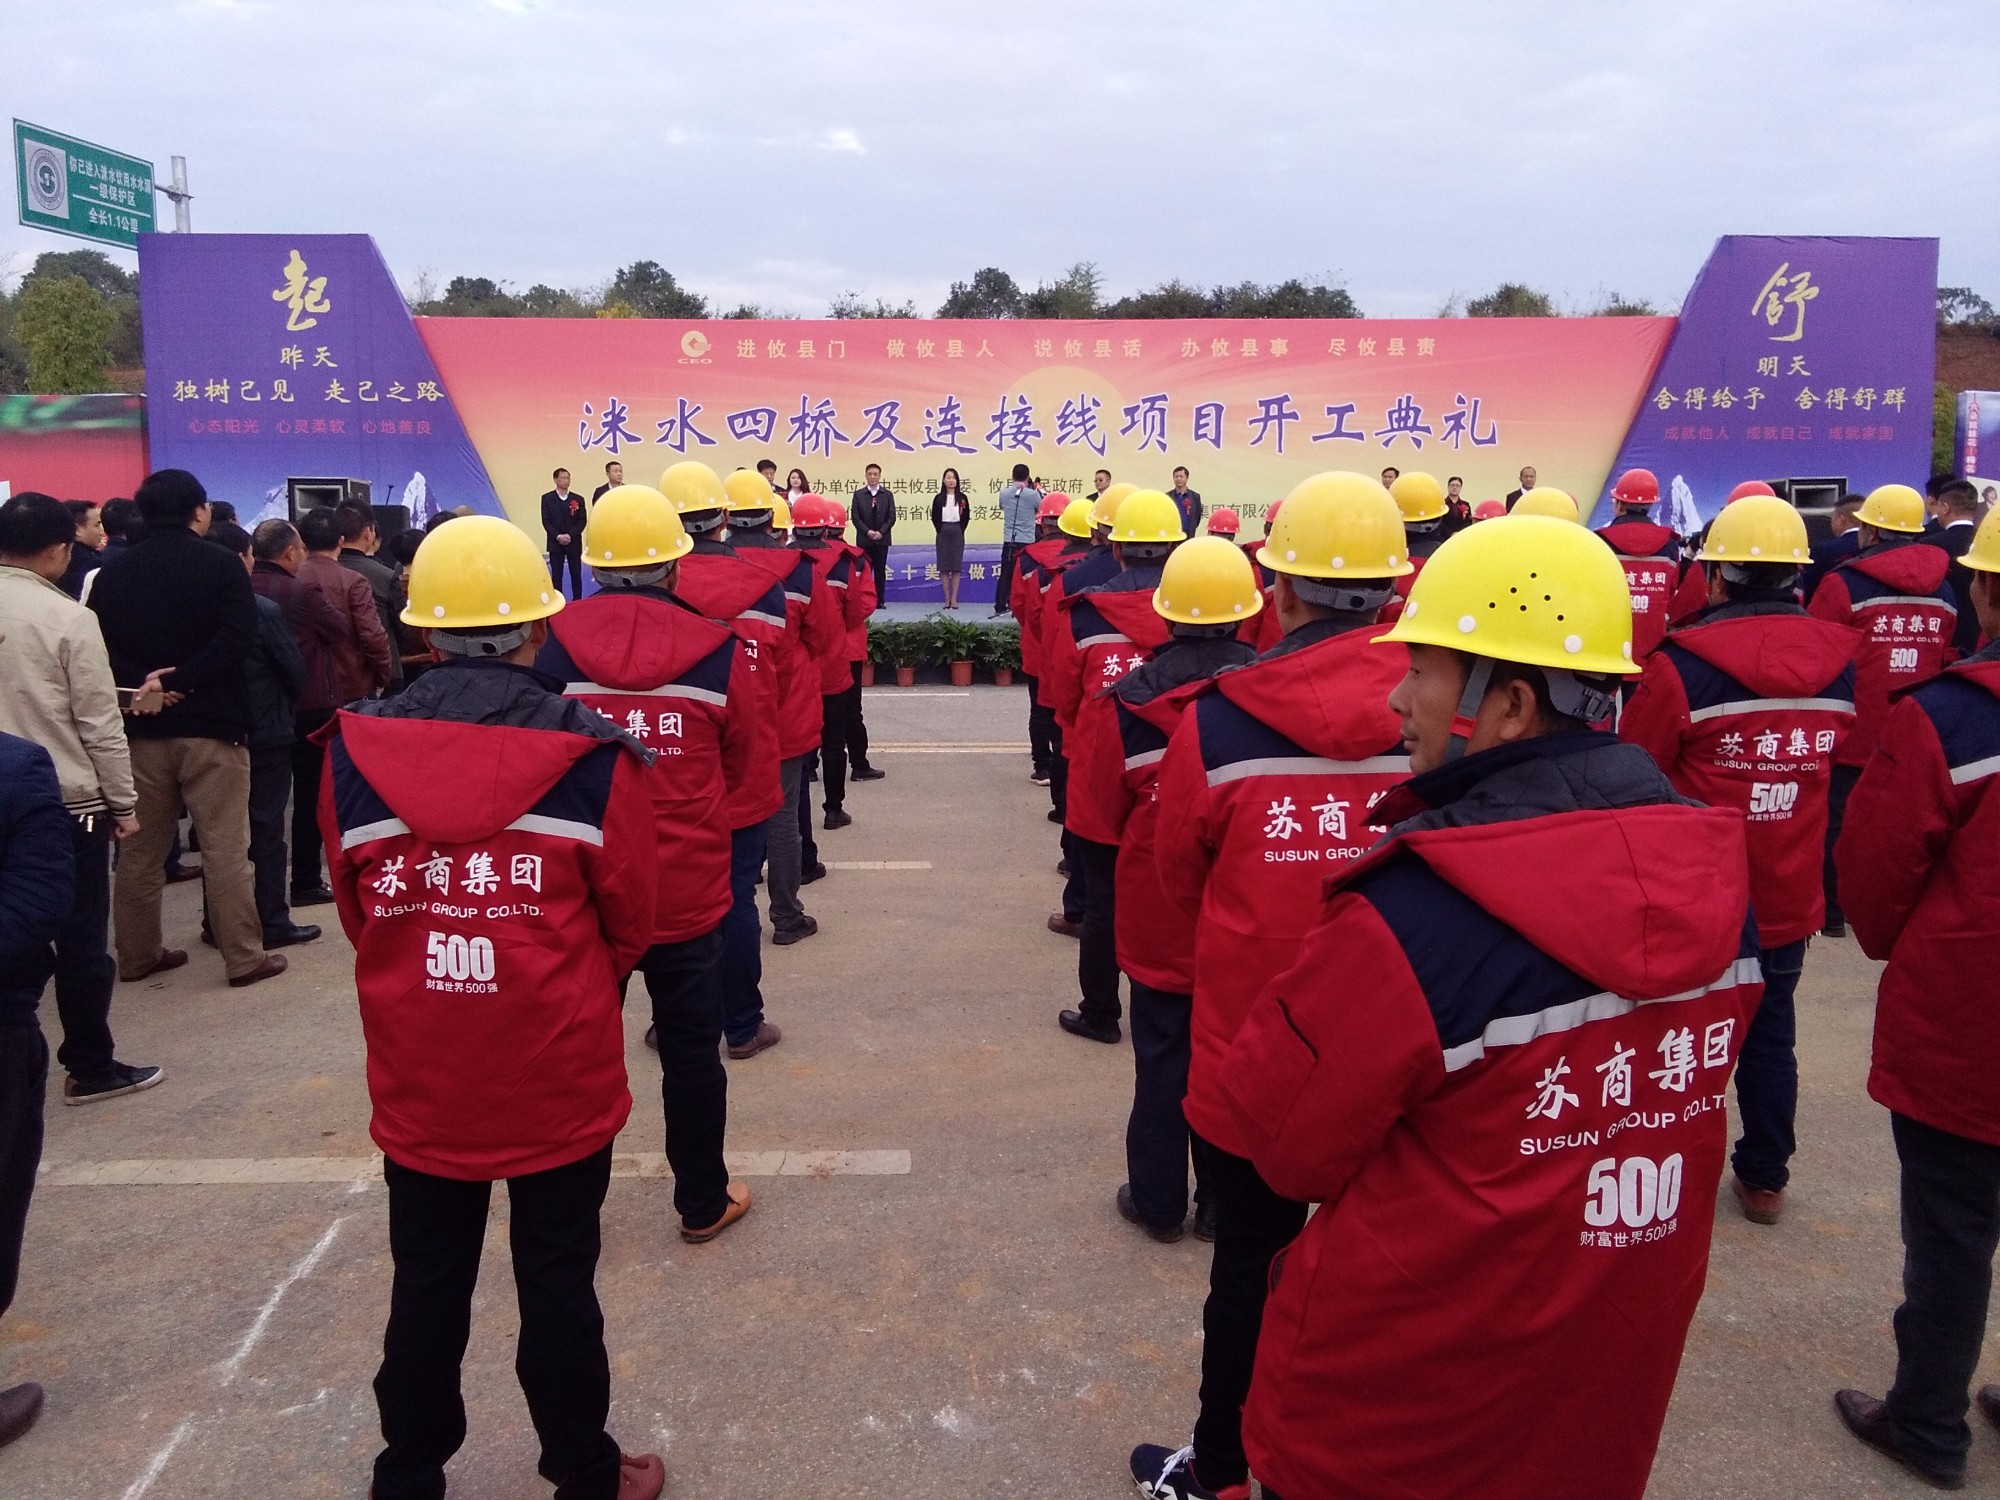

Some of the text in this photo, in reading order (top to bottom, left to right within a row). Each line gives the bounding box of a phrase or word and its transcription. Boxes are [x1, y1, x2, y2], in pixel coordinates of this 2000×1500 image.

[89, 183, 136, 207] 一级保护区
[89, 207, 139, 233] 全长1.1公里
[1752, 262, 1820, 342] 舒
[280, 344, 338, 370] 昨天
[737, 337, 1436, 358] 进攸县门 做攸县人 说攸县话 办攸县事 尽攸县责
[1757, 355, 1812, 378] 明天
[1653, 386, 1906, 412] 舍得给予 舍得舒群
[189, 419, 432, 435] 心态阳光 心灵柔软 心地善良
[1663, 426, 1730, 440] 成就他人
[1746, 426, 1813, 440] 成就自己
[1873, 615, 1941, 634] 苏商集团
[1889, 648, 1918, 668] 500
[1716, 728, 1835, 760] 苏商集团
[1757, 762, 1797, 772] GROUP
[1750, 781, 1799, 814] 500
[1264, 850, 1319, 863] SUSUN
[372, 850, 543, 898] 苏商集团
[374, 901, 427, 918] SUSUN
[431, 902, 478, 919] GROUP
[426, 930, 496, 982] 500
[426, 979, 498, 994] 财富世界500强
[1525, 1018, 1736, 1120] 苏商集团
[1519, 1130, 1600, 1156] SUSUN
[1607, 1112, 1676, 1139] GROUP
[1583, 1152, 1683, 1228] 500
[1580, 1217, 1678, 1248] 财富世界500强
